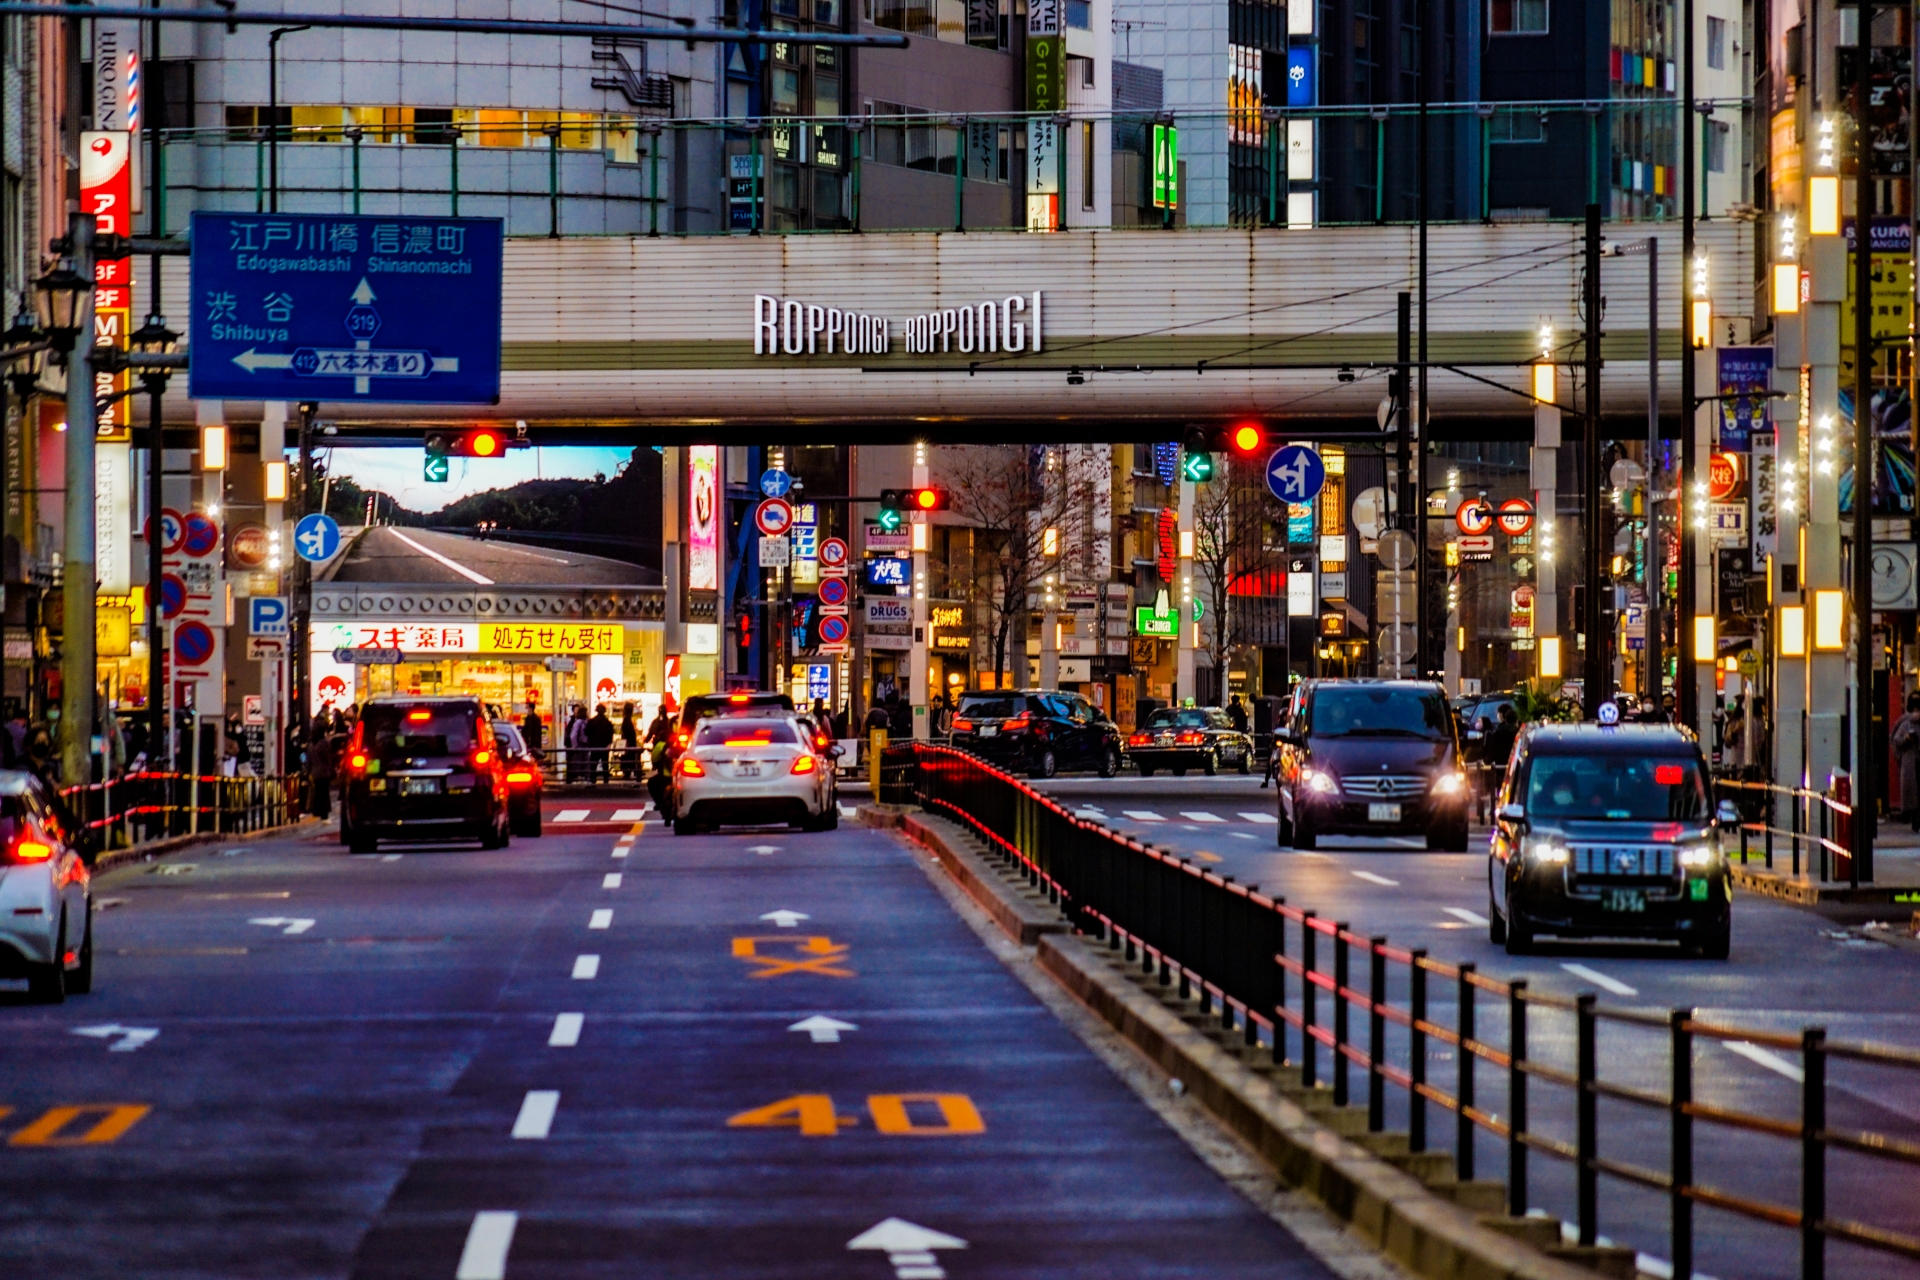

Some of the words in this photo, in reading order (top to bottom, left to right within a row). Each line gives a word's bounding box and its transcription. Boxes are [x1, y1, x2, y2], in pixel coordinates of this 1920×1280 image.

[101, 31, 117, 81] HIRO
[818, 152, 837, 165] SHAVE
[230, 221, 358, 252] 江戸川橋
[371, 224, 466, 254] 信濃町
[1846, 226, 1910, 238] SKURA
[96, 265, 117, 280] 3F
[237, 255, 351, 272] Edogawabashi
[368, 257, 472, 274] Shinanomachi
[95, 290, 119, 307] 2F
[351, 315, 375, 331] 319
[755, 294, 888, 355] ROPPONGI
[905, 290, 1041, 353] ROPPONGI
[211, 324, 289, 342] Shibuya
[295, 354, 316, 368] 412
[322, 353, 418, 372] 六本木通り
[98, 459, 112, 581] DIFFERENCE
[253, 599, 284, 632] P
[870, 606, 907, 617] DRUGS
[357, 625, 464, 648] スギ薬局
[493, 626, 613, 651] 処方せん受付
[726, 1093, 986, 1135] 40
[0, 1104, 151, 1147] 0
